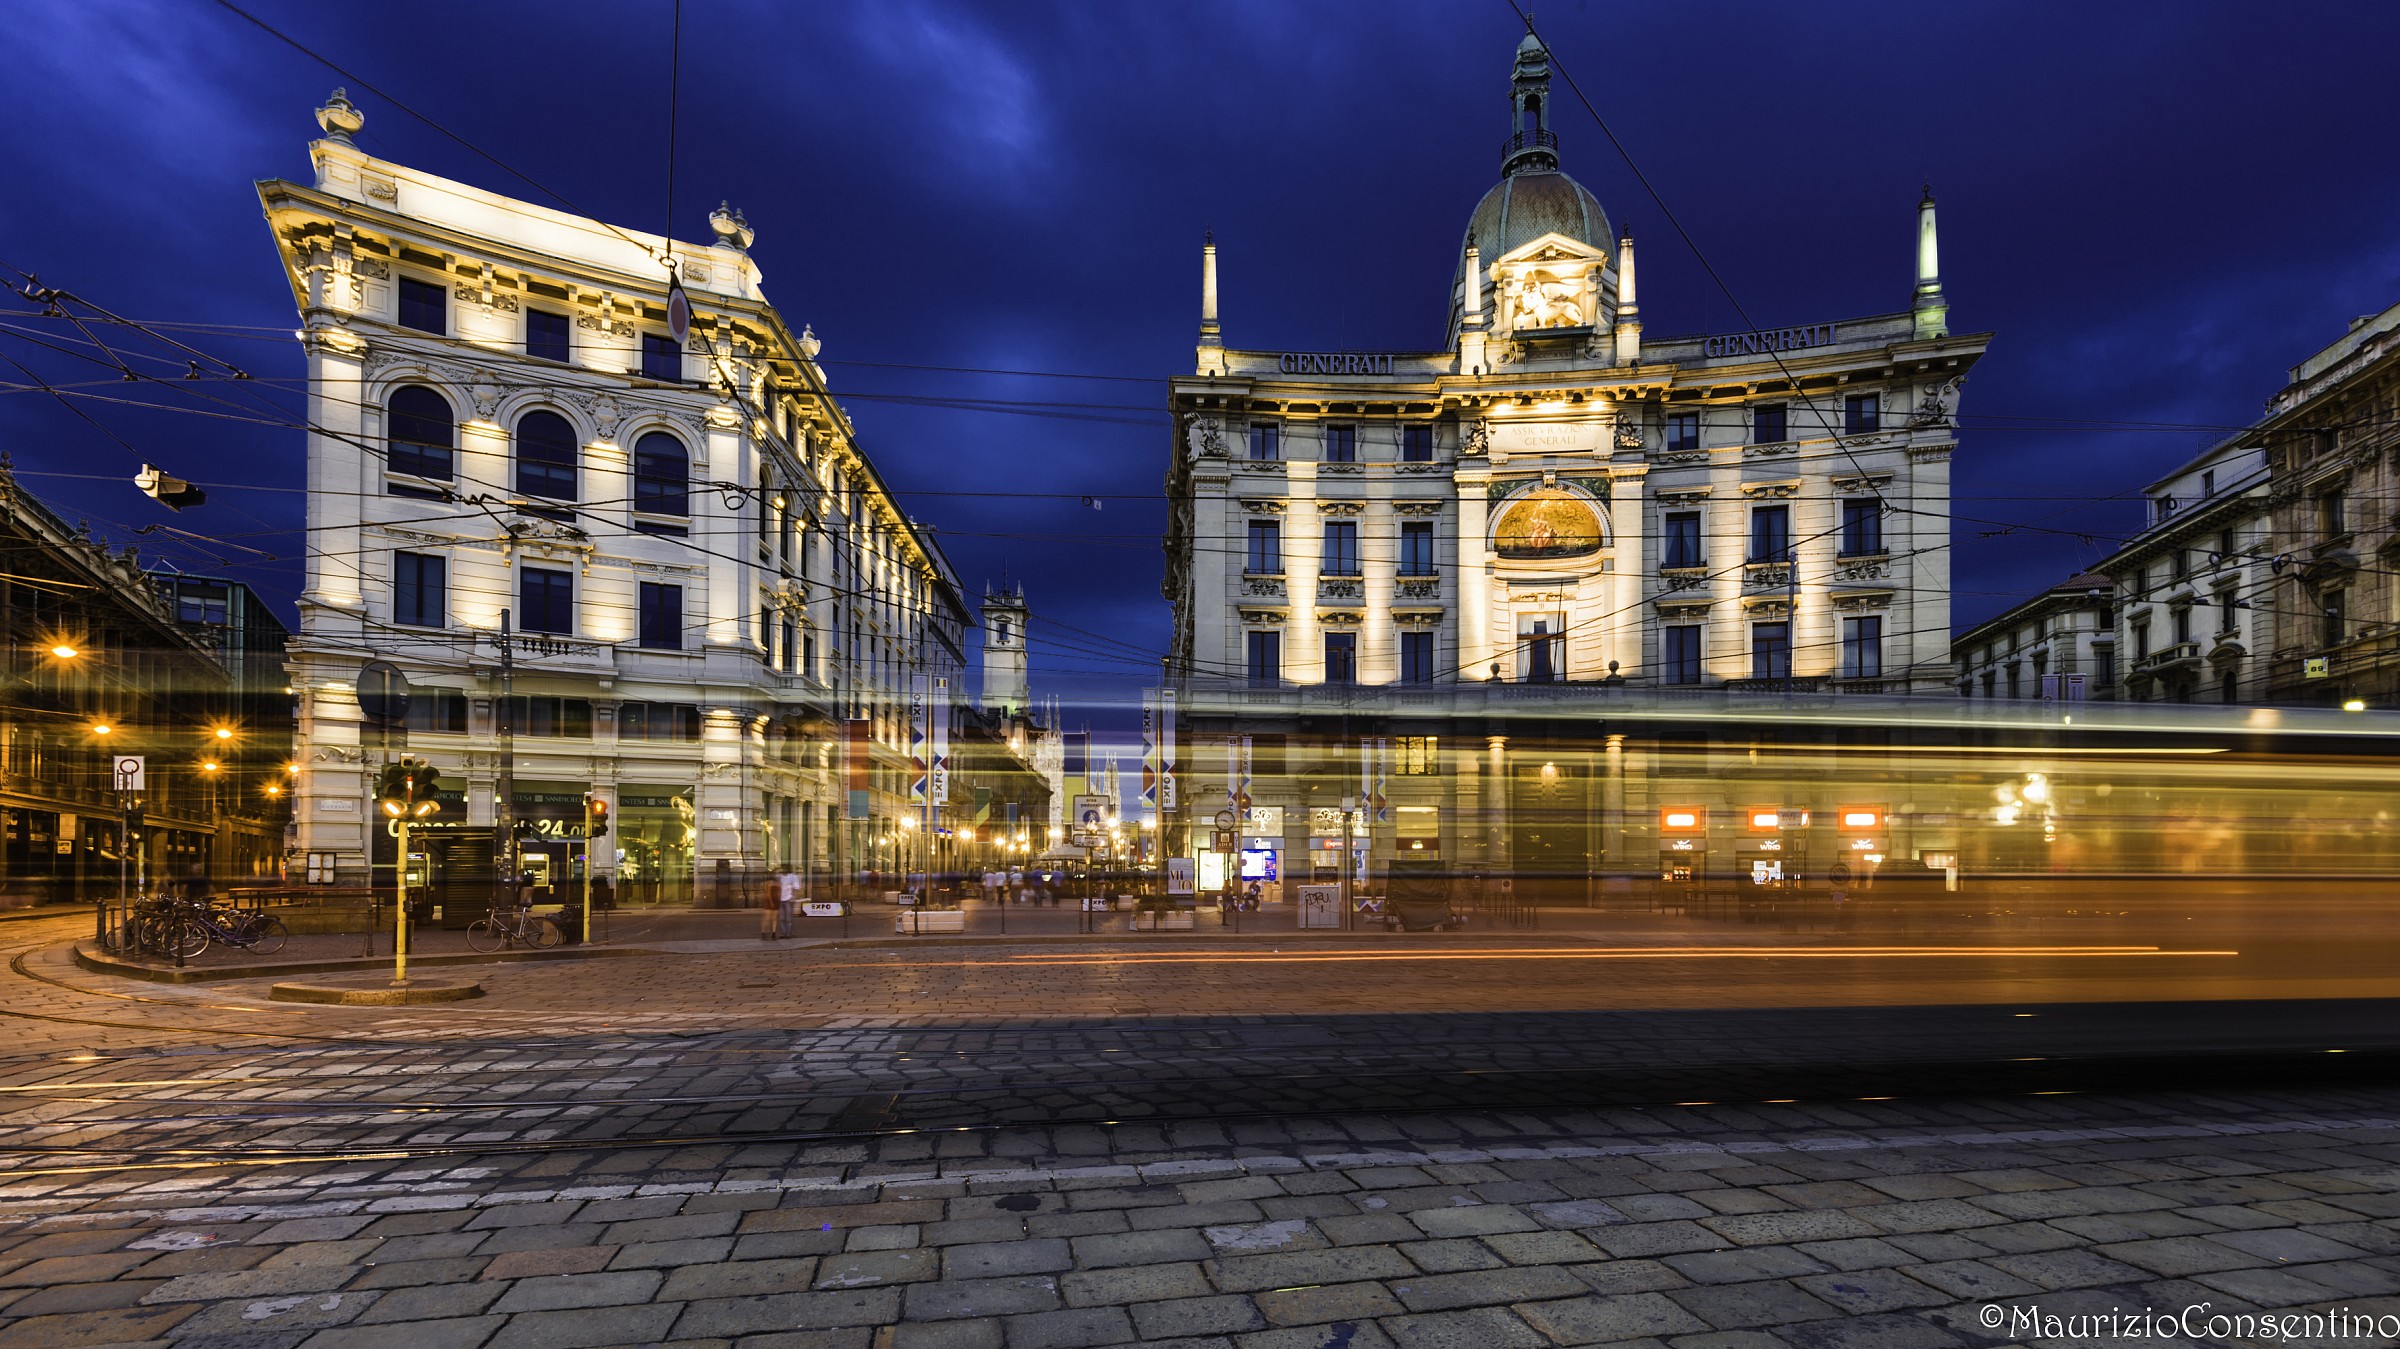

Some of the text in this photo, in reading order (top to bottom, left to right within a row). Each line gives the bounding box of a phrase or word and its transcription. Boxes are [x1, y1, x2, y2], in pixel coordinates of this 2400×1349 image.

[1704, 323, 1837, 358] GENERALI
[1280, 353, 1394, 374] GENERALI
[1525, 436, 1576, 446] GENERALI
[913, 693, 921, 722] EXPO
[1143, 706, 1151, 733] EXPO
[934, 769, 942, 798] EXPO
[1163, 776, 1171, 804] EXPO
[538, 819, 565, 835] 24
